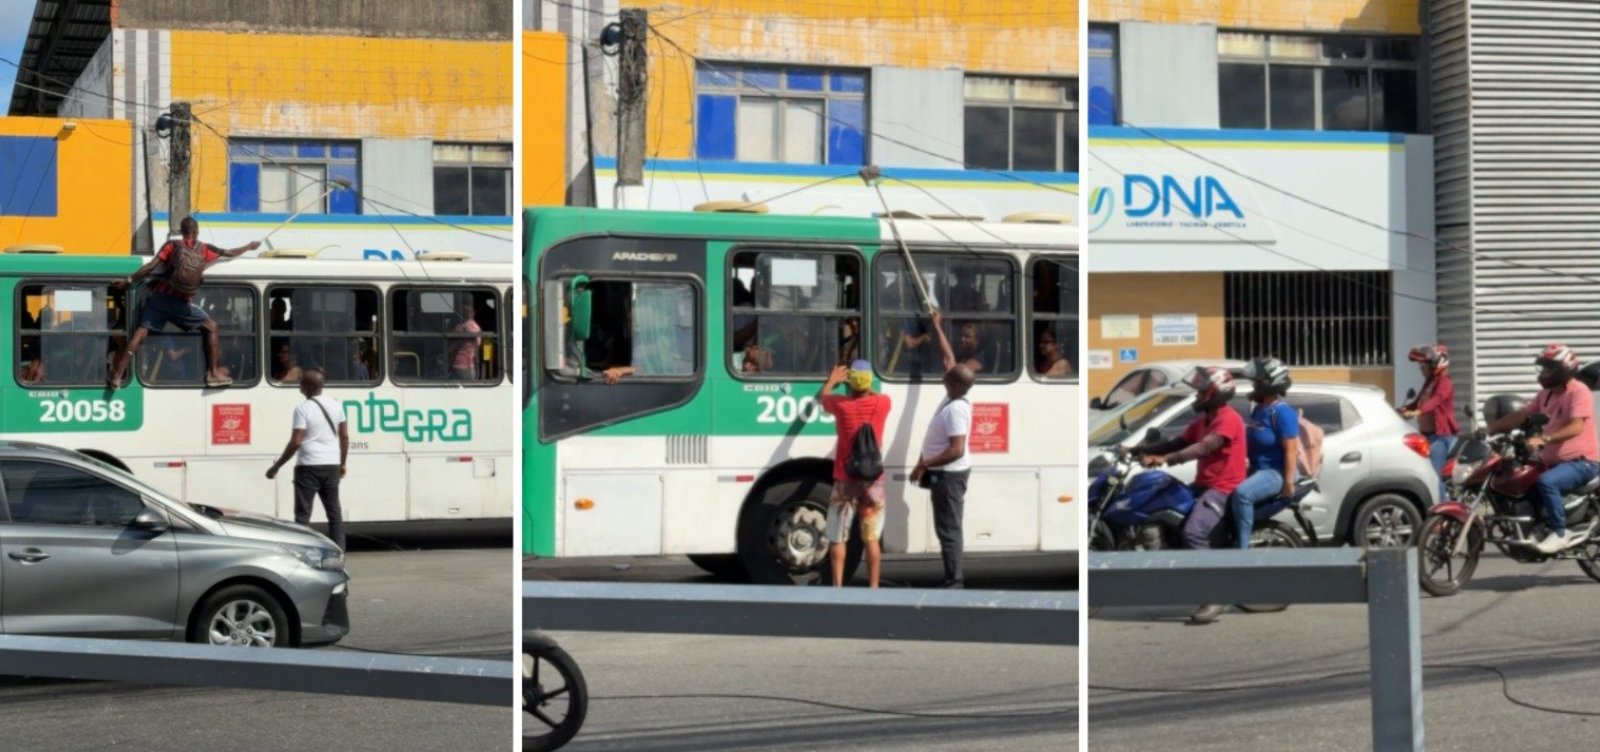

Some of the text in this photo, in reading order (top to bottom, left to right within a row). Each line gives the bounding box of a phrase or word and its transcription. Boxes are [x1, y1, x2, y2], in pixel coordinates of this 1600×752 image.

[1124, 174, 1244, 218] DNA
[39, 400, 125, 422] 20058
[757, 396, 836, 423] 200
[348, 441, 369, 450] rans
